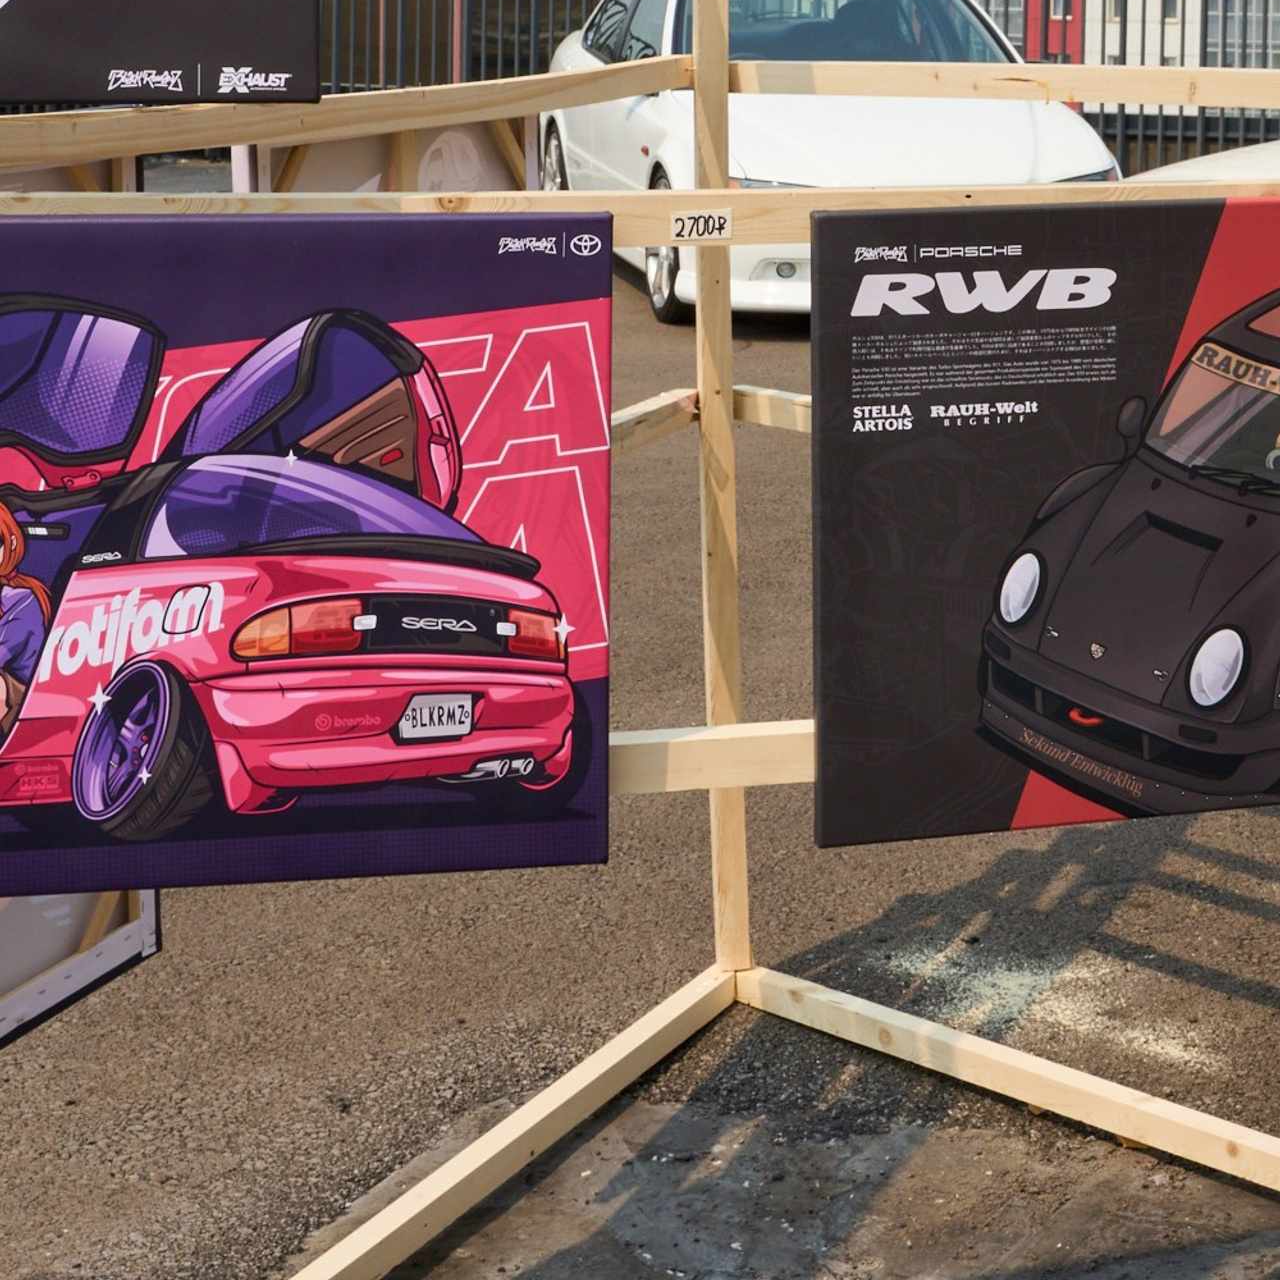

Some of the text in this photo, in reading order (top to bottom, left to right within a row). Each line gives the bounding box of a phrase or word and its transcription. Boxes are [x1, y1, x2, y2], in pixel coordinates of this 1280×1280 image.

[217, 67, 292, 93] EXHAUST
[920, 245, 1022, 258] PORSCHE
[851, 268, 1117, 317] RWB
[853, 405, 912, 418] STELLA
[930, 401, 1038, 417] RAUH-Welt
[853, 417, 914, 432] ARTOIS
[82, 552, 122, 563] SERA
[402, 617, 477, 632] SERA
[334, 714, 381, 727] brembo
[411, 705, 465, 728] BLKRMZ
